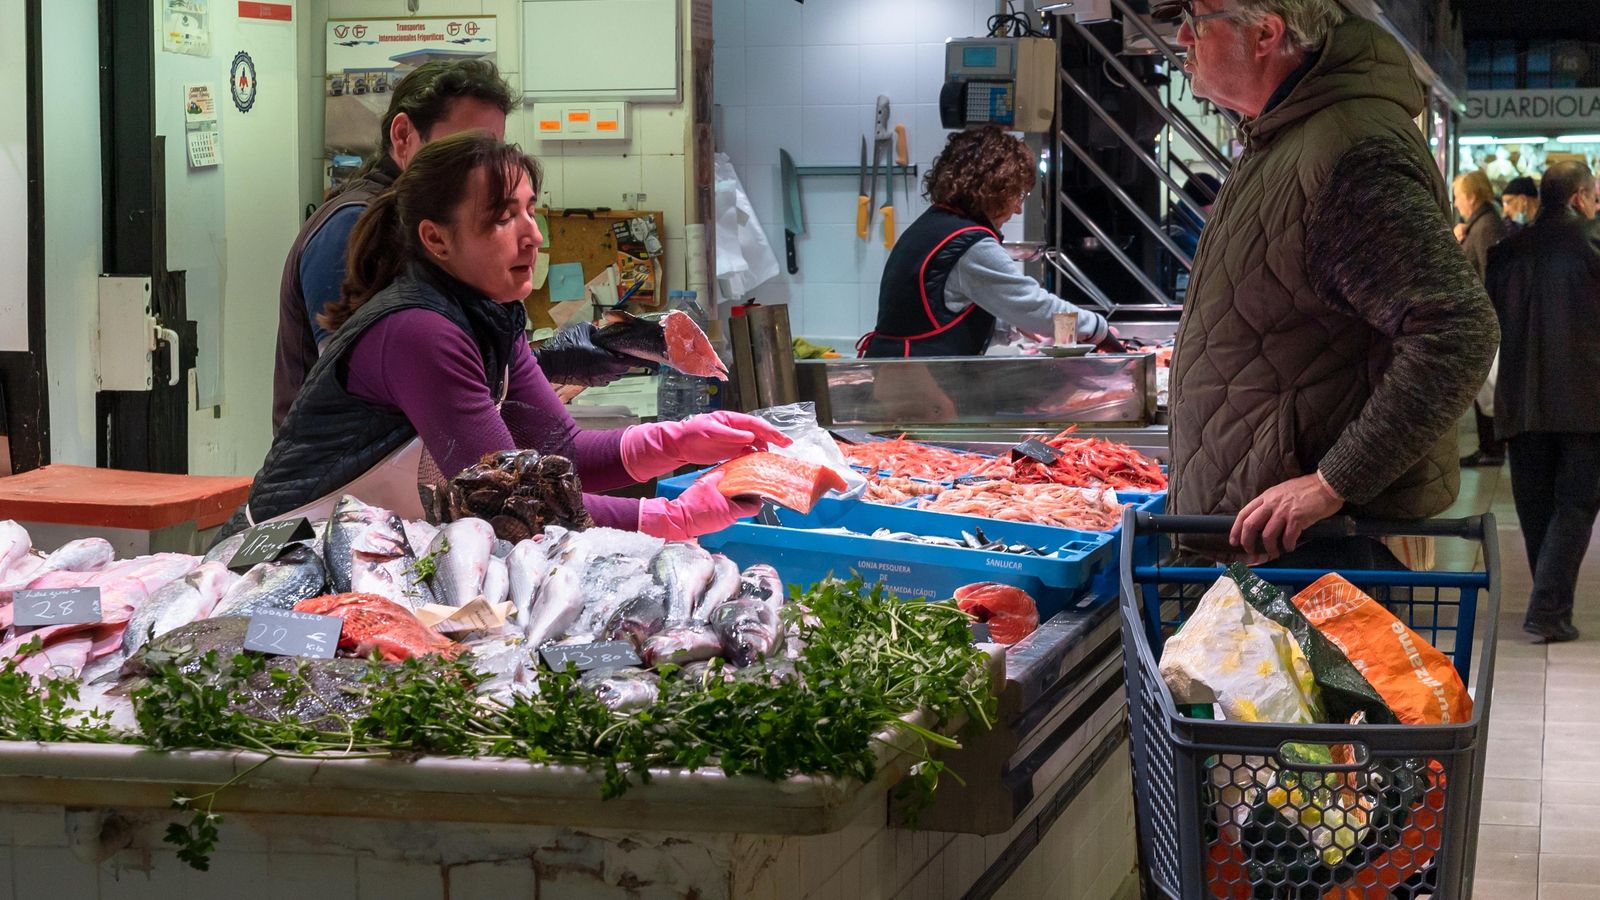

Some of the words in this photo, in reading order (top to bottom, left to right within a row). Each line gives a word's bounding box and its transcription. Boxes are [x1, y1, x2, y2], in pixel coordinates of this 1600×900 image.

[396, 23, 426, 31] Transportes
[1465, 95, 1600, 119] GUARDIOLA
[857, 560, 878, 569] LONJA
[878, 563, 911, 573] PESQUERA
[879, 573, 888, 581] DE
[30, 600, 76, 619] 28
[248, 623, 288, 652] 22
